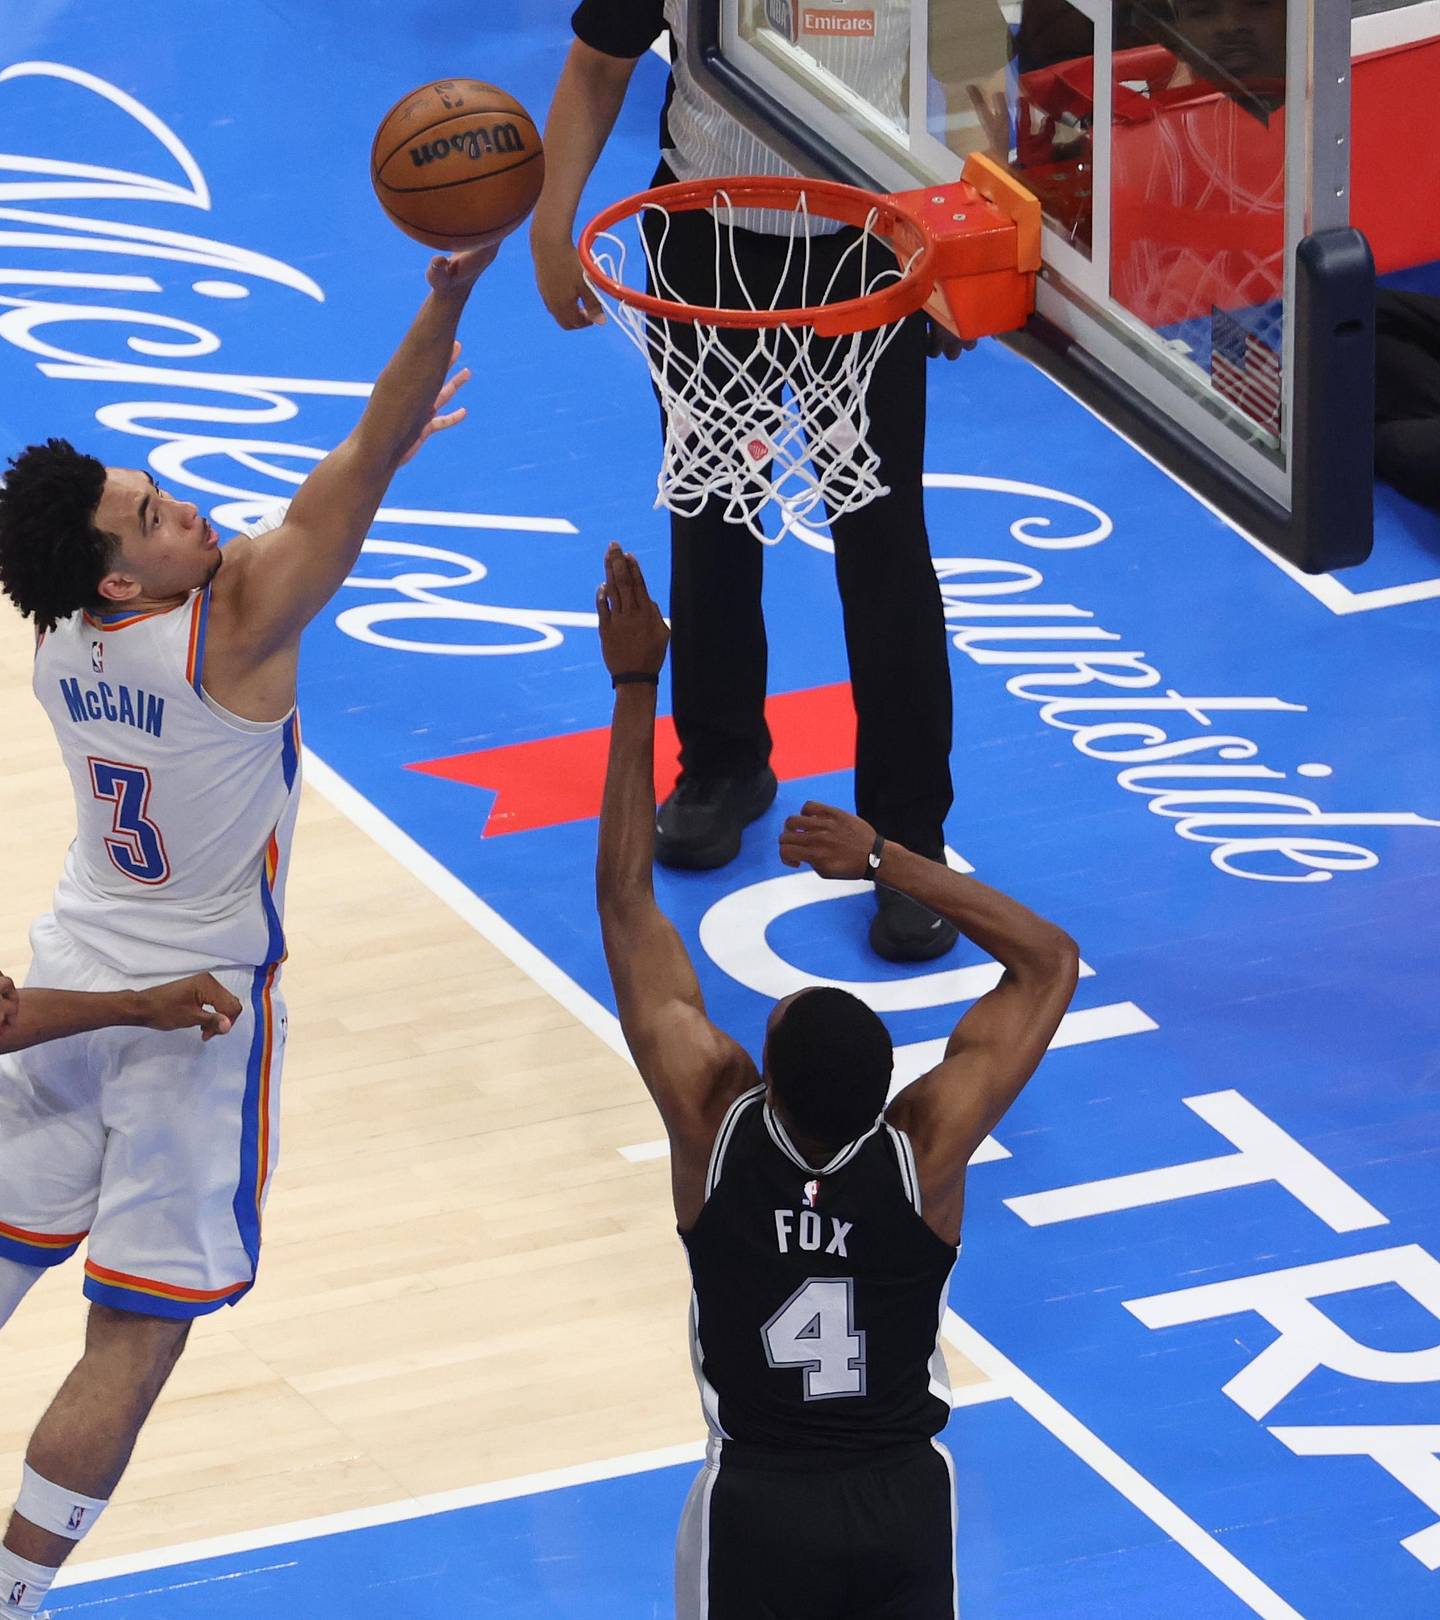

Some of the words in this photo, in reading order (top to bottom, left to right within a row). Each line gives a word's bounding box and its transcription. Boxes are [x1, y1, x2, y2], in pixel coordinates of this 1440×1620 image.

[804, 14, 873, 31] Emirates
[410, 121, 525, 167] Wilson
[60, 677, 165, 738] McCAIN
[87, 755, 171, 886] 3
[774, 1209, 854, 1258] FOX
[760, 1276, 867, 1401] 4
